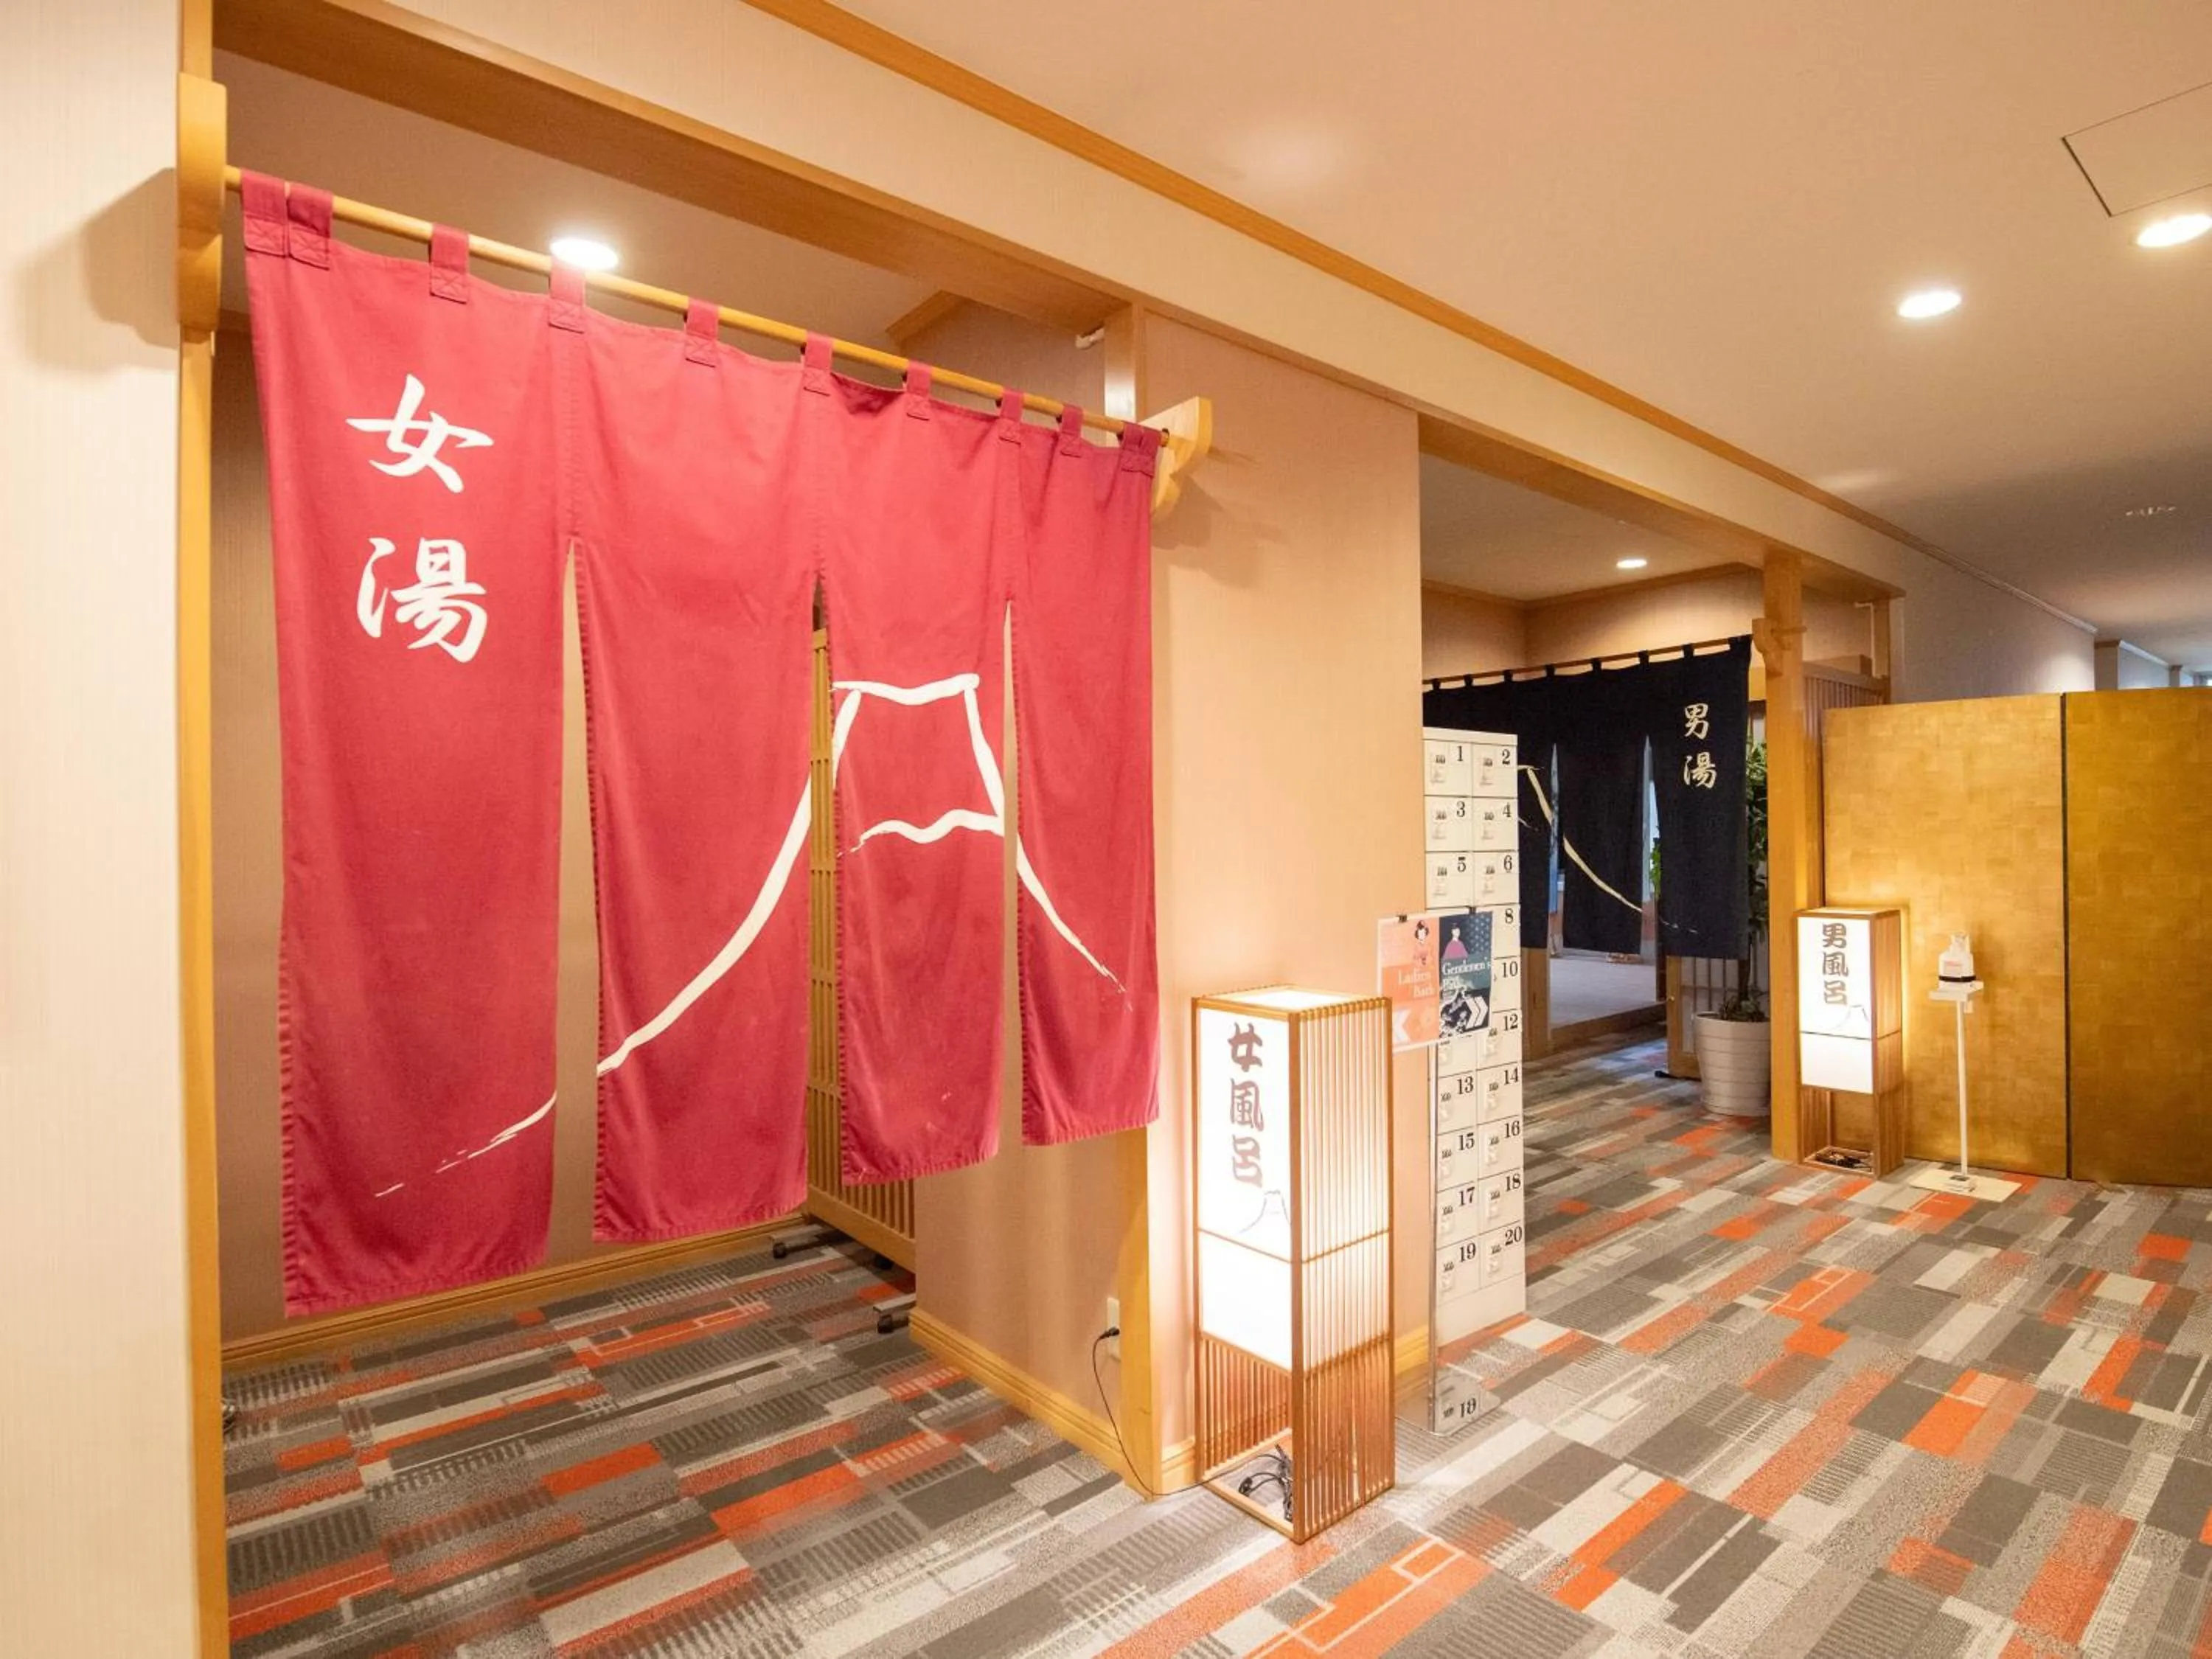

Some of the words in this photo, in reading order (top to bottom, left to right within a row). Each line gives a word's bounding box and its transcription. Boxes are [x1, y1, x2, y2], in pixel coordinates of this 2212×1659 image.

[345, 373, 495, 664] 女湯
[1458, 745, 1464, 762] 1
[1683, 703, 1717, 789] 男湯
[1502, 748, 1511, 765] 2
[1456, 801, 1466, 818] 3
[1503, 804, 1512, 818] 4
[1457, 856, 1467, 872] 5
[1503, 855, 1513, 874] 6
[1505, 908, 1514, 924] 8
[1502, 961, 1518, 978] 10
[1822, 922, 1849, 1005] 男風呂
[1504, 1014, 1518, 1032] 12
[1457, 1076, 1474, 1095] 13
[1504, 1067, 1519, 1085] 14
[1227, 1021, 1264, 1189] 女風呂
[1505, 1120, 1520, 1139] 16
[1459, 1132, 1475, 1151] 15
[1506, 1173, 1521, 1192] 18
[1460, 1186, 1475, 1206] 17
[1504, 1226, 1523, 1246] 20
[1460, 1242, 1476, 1263] 19
